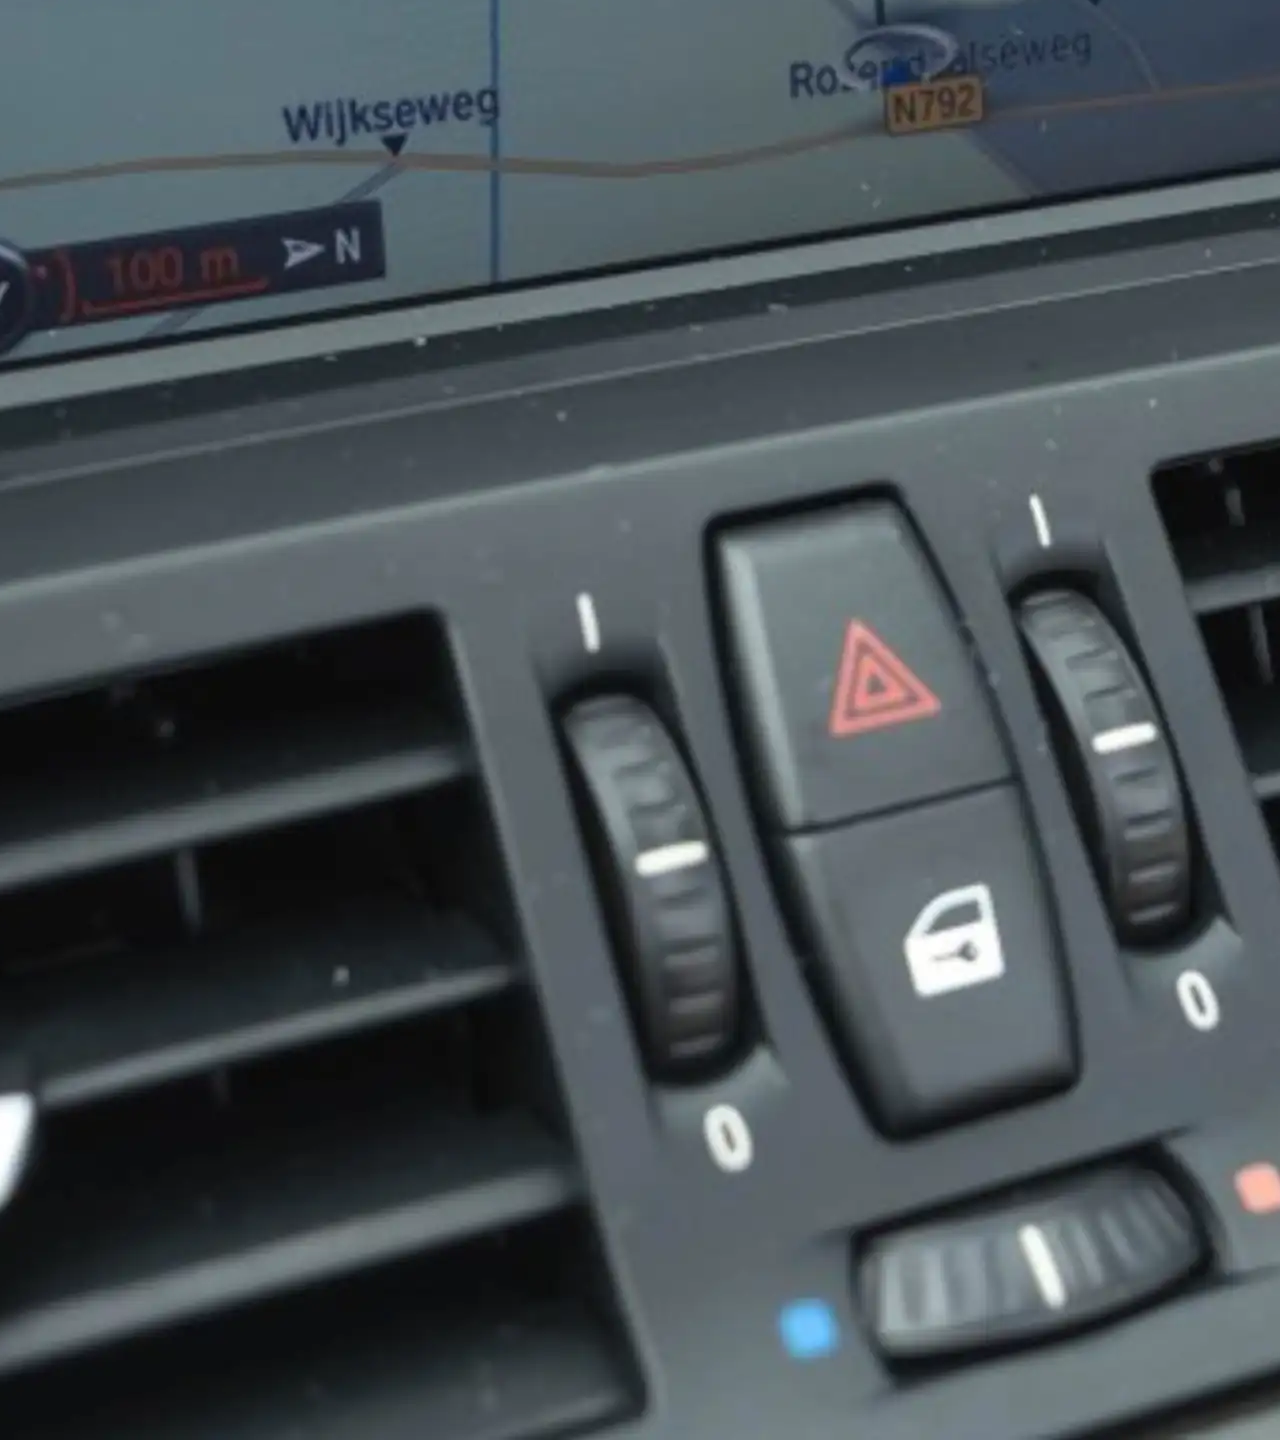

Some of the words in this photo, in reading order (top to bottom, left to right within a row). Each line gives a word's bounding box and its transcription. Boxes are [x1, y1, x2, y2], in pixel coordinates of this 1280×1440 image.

[282, 85, 501, 146] Wijkseweg
[893, 83, 976, 124] N792
[334, 227, 362, 264] N
[106, 248, 183, 293] 100
